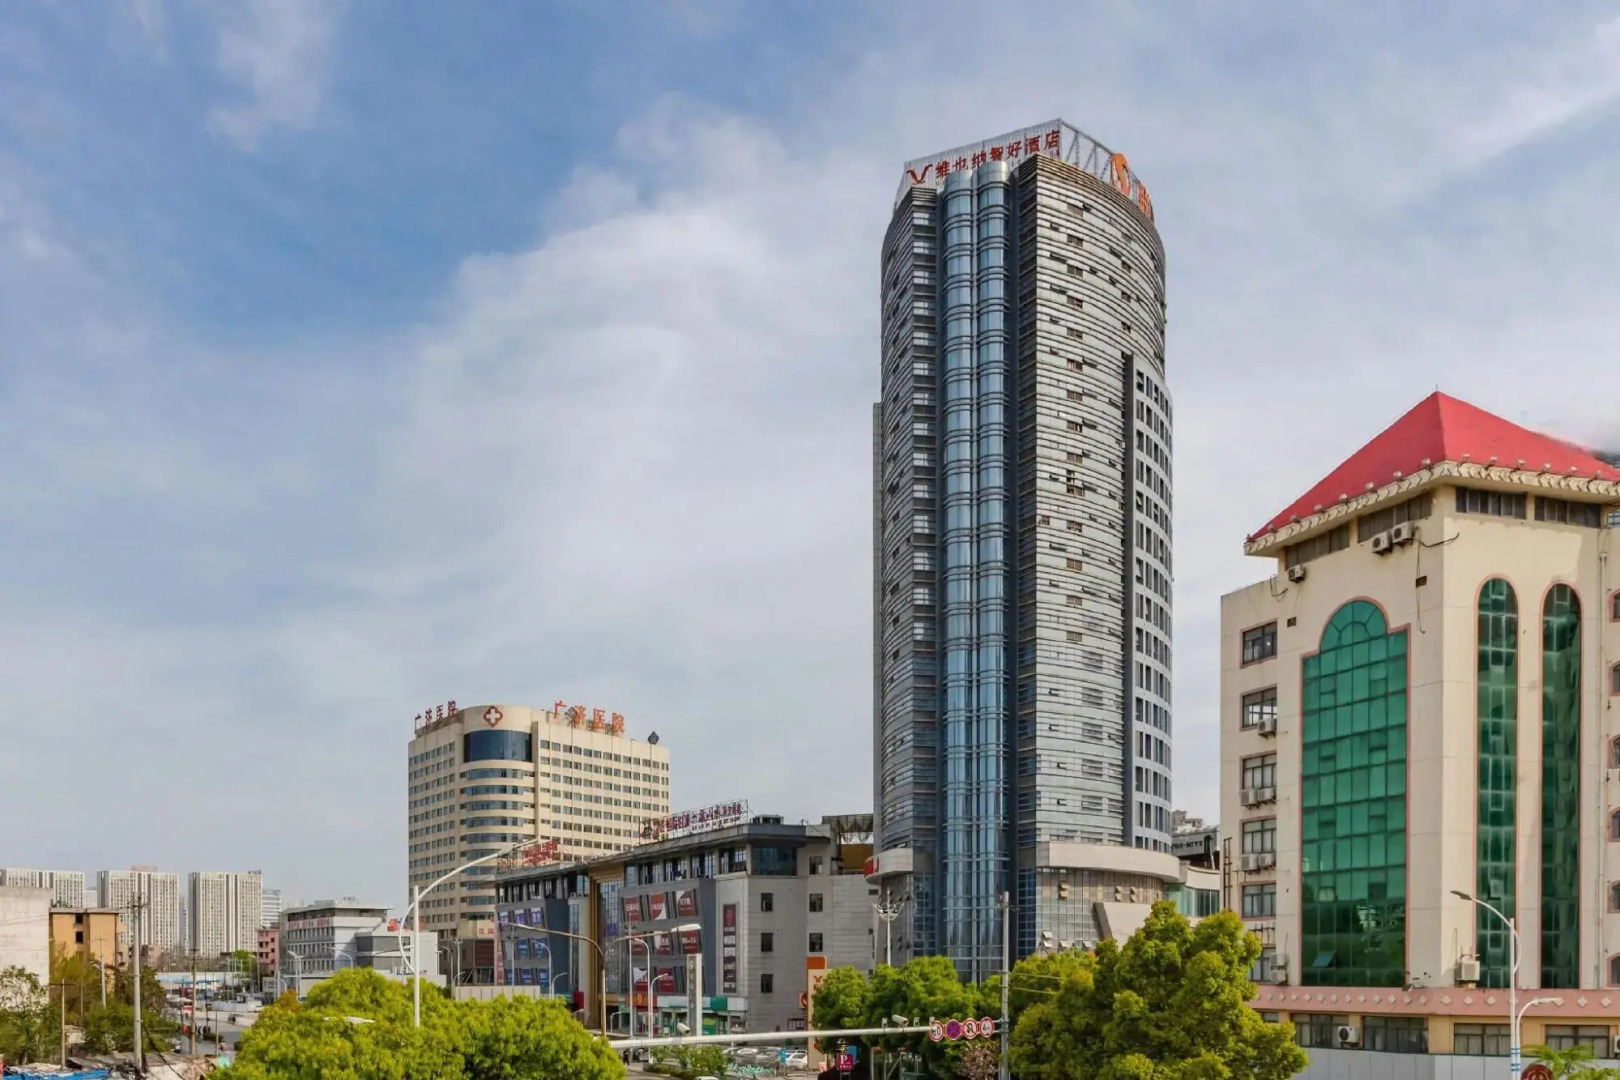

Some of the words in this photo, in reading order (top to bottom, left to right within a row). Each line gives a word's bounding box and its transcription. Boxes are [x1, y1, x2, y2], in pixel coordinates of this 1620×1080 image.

[935, 129, 1060, 178] 维也纳智好酒店
[553, 699, 625, 733] 广济医院
